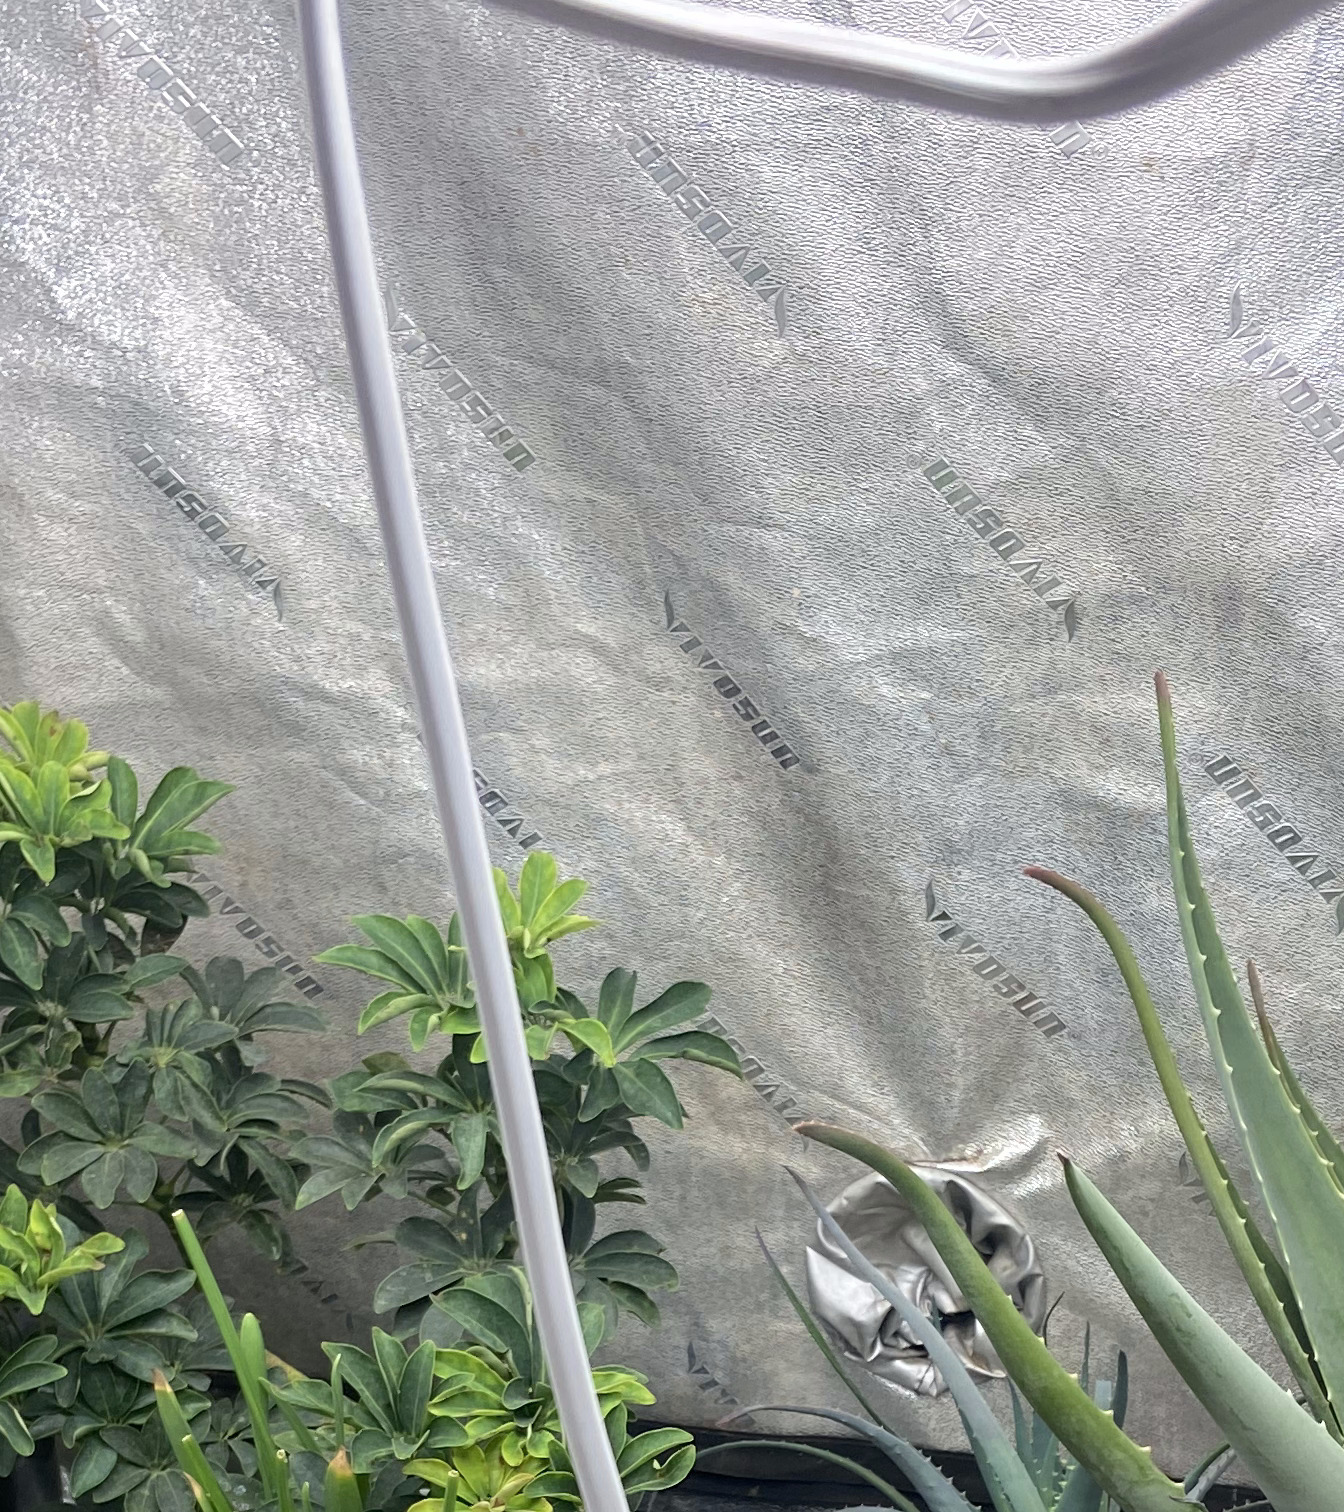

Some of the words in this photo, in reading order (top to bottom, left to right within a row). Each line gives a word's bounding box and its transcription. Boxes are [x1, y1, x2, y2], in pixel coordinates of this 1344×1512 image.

[627, 130, 787, 337] VIVOSUN
[386, 281, 535, 471] VIVOSUN
[129, 442, 284, 621] VIVOSUN
[923, 455, 1077, 642] VIVOSUN
[664, 588, 800, 770] VIVOSUN
[925, 878, 1067, 1038] VIVOSUN
